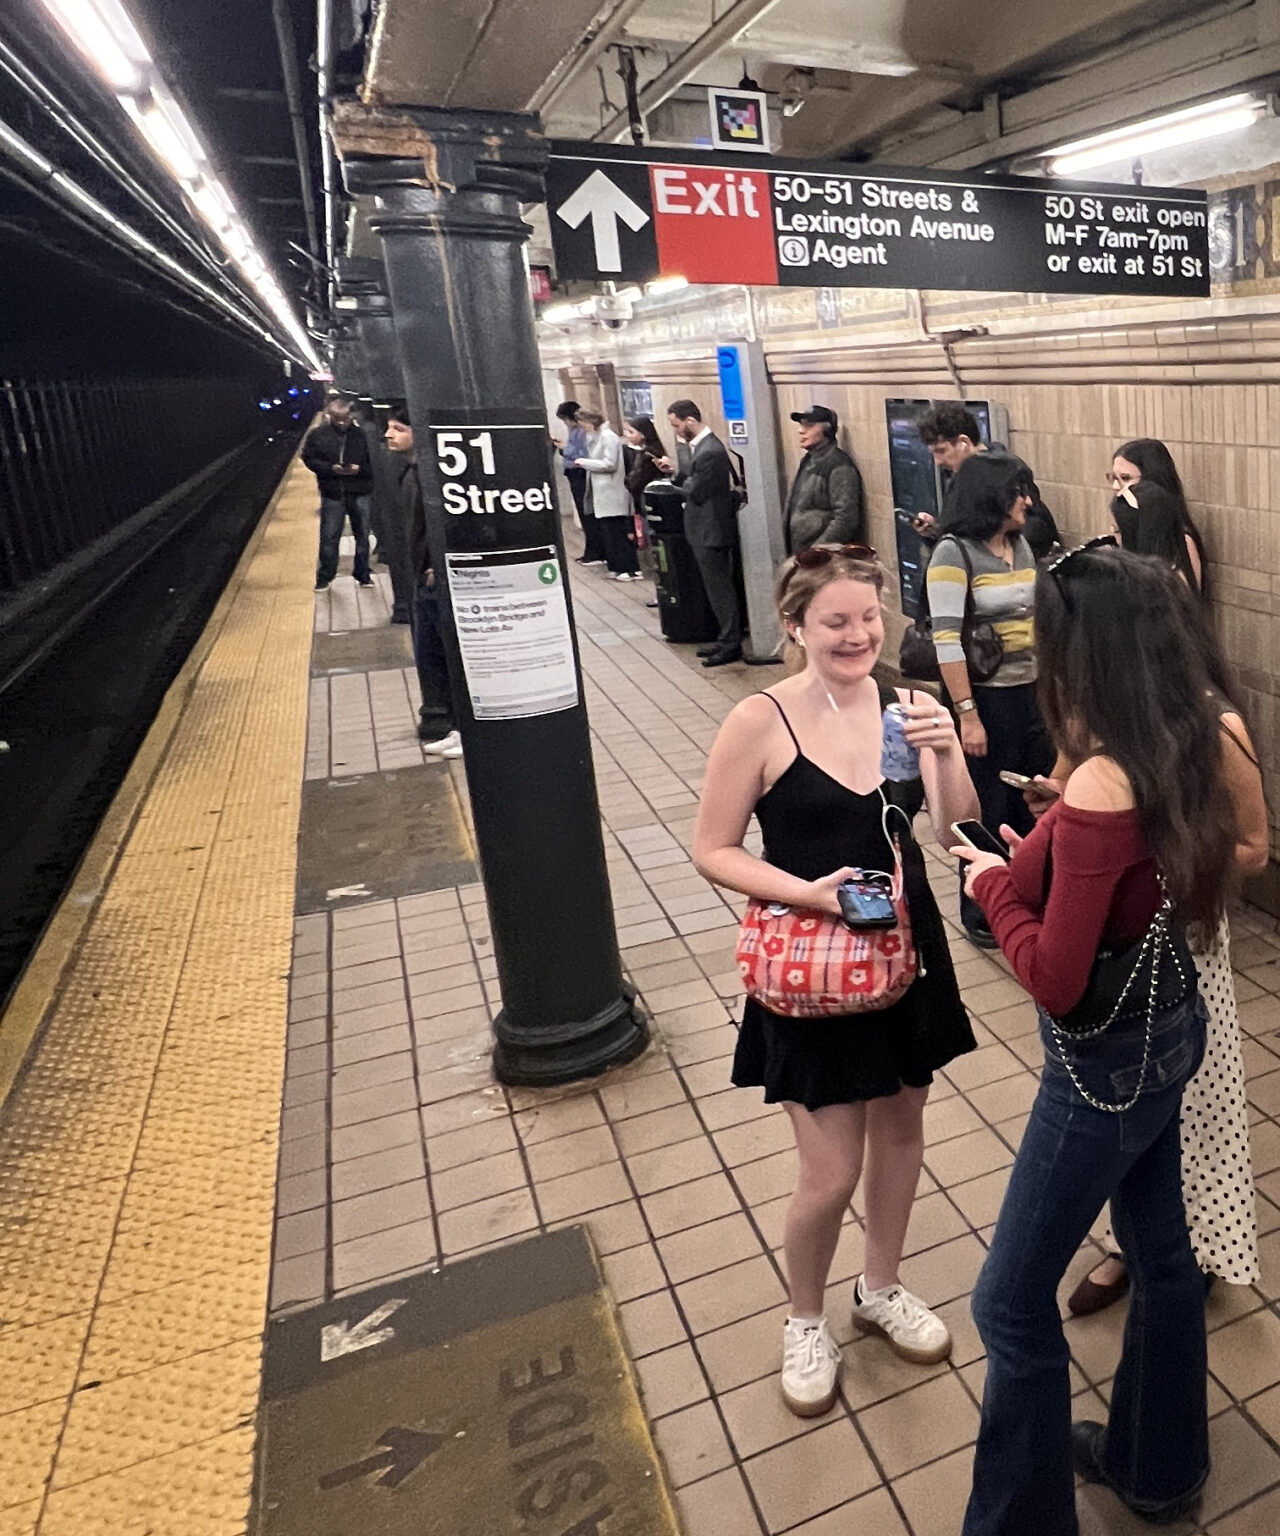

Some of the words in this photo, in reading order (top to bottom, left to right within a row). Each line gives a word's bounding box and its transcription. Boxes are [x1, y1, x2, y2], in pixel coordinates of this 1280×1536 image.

[652, 168, 760, 218] Exit
[774, 177, 853, 205] 50-51
[862, 182, 952, 210] Streets
[962, 190, 979, 213] &
[775, 207, 900, 239] Lexington
[910, 215, 994, 242] Avenue
[1045, 196, 1075, 219] 50
[1080, 197, 1104, 221] St
[1111, 202, 1149, 224] exit
[1156, 208, 1206, 228] open
[812, 239, 888, 268] Agent
[1045, 223, 1090, 246] M-F
[1096, 226, 1188, 254] 7am-7pm
[1047, 254, 1070, 272] or
[1078, 252, 1117, 275] exit
[1124, 255, 1145, 275] at
[1152, 256, 1175, 276] 51
[1181, 256, 1203, 278] St
[435, 431, 496, 477] 51
[442, 482, 553, 515] Street
